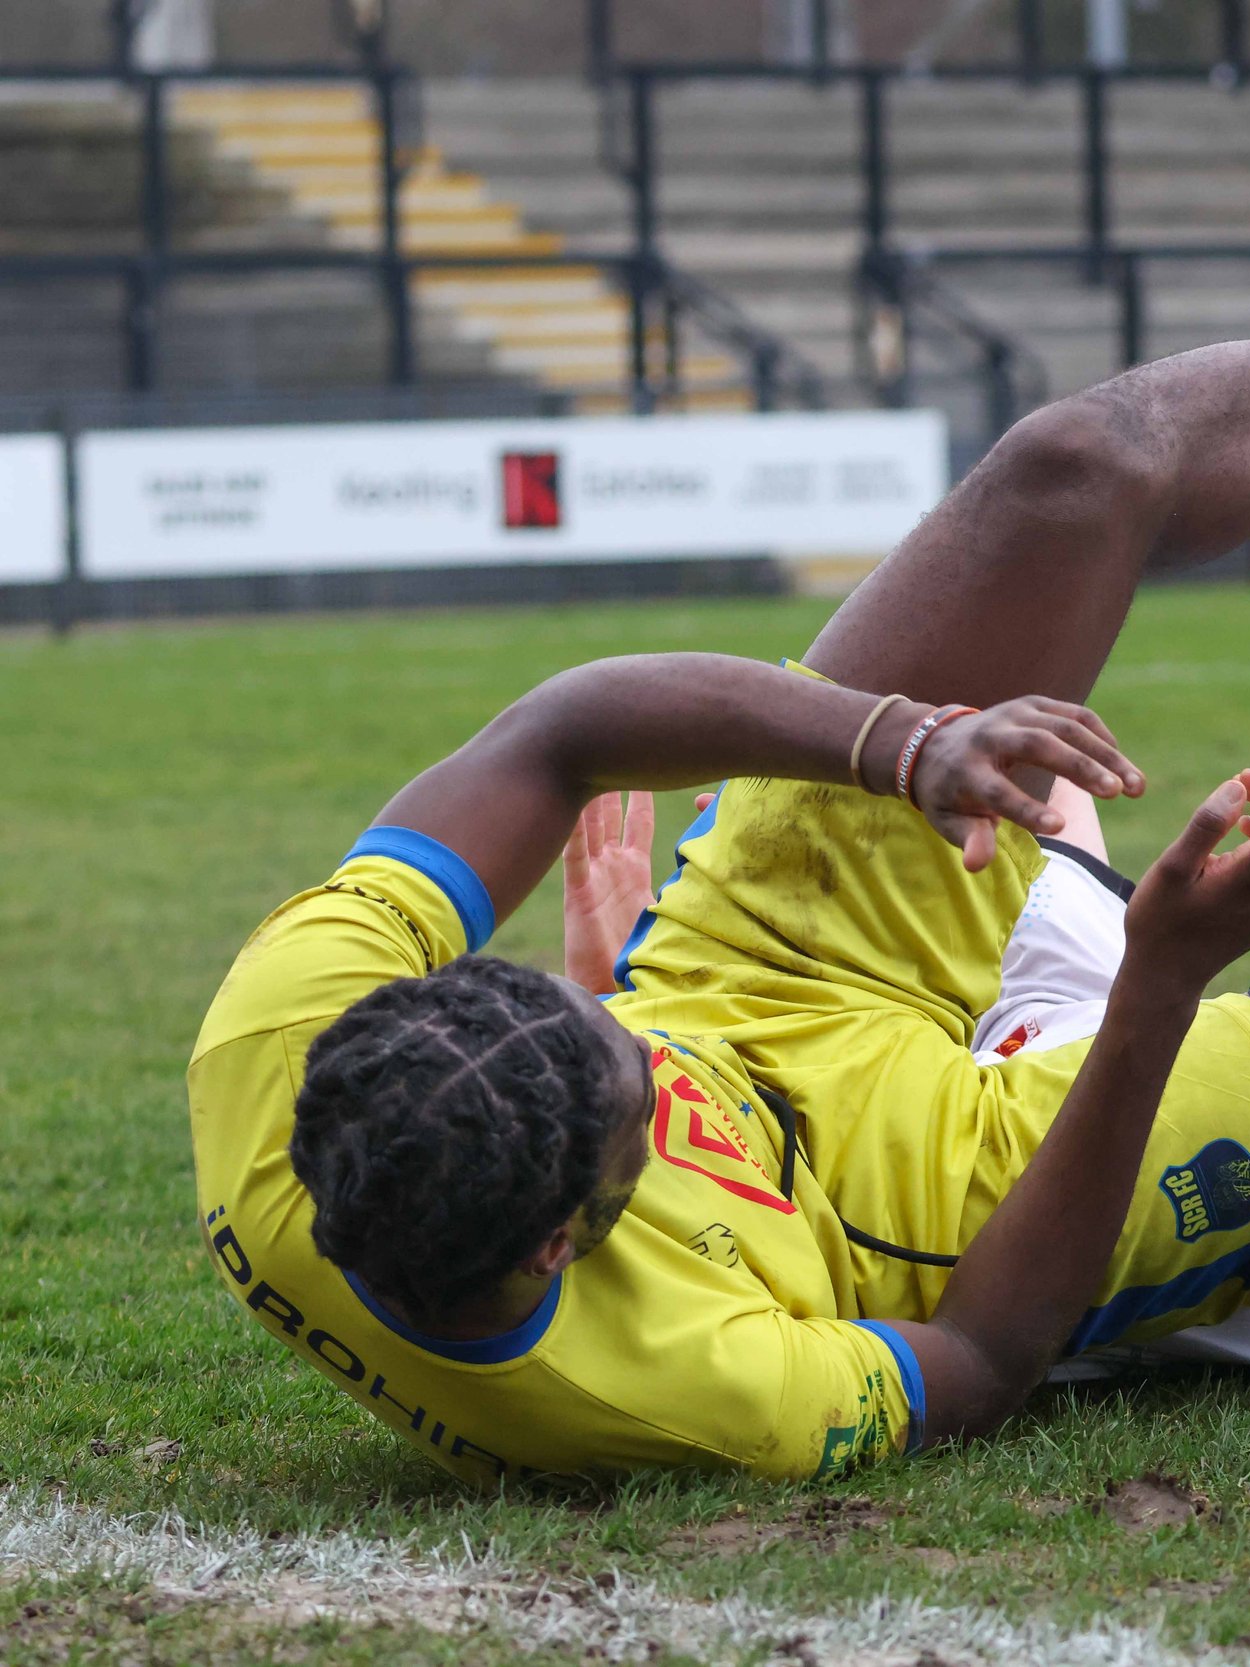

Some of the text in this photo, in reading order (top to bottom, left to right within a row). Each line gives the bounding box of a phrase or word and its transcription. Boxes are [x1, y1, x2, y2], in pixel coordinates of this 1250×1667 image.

[898, 727, 928, 794] FORGIVEN
[1166, 1170, 1210, 1237] SCR FC
